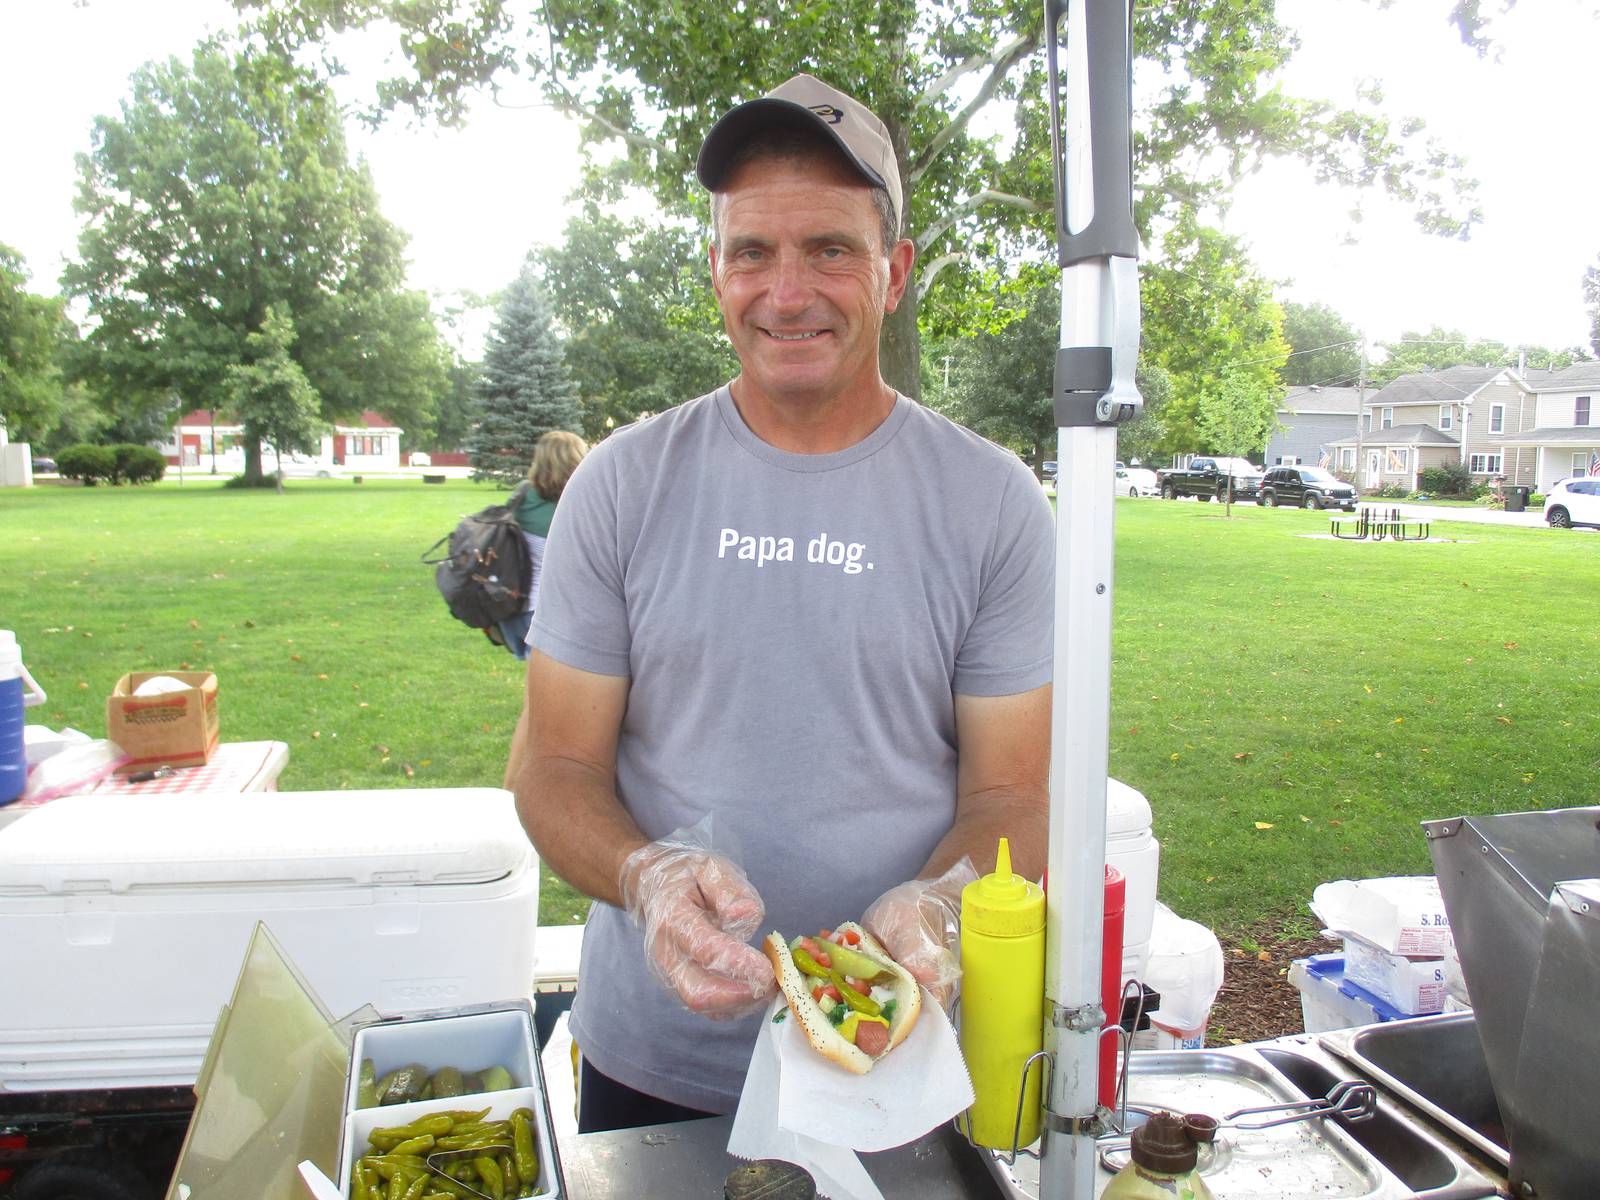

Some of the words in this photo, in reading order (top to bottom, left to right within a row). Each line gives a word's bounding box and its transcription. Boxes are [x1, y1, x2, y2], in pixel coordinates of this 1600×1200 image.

[717, 528, 794, 568] Papa
[807, 532, 875, 575] dog.
[1421, 914, 1431, 926] S.
[1434, 968, 1444, 981] S.
